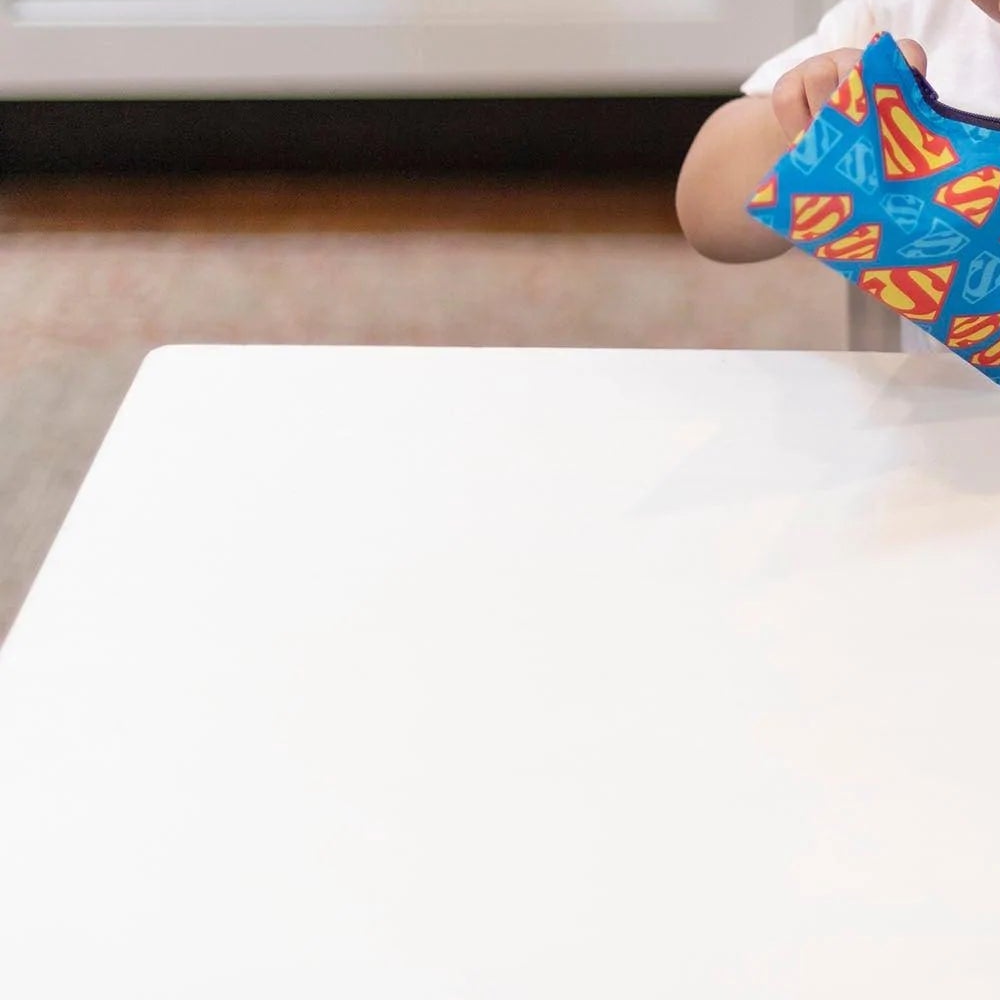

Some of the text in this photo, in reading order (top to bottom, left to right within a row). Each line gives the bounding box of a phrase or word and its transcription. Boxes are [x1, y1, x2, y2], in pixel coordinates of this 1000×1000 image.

[876, 94, 952, 181] S
[793, 195, 848, 241] S
[822, 223, 880, 260] S
[861, 266, 949, 319] S
